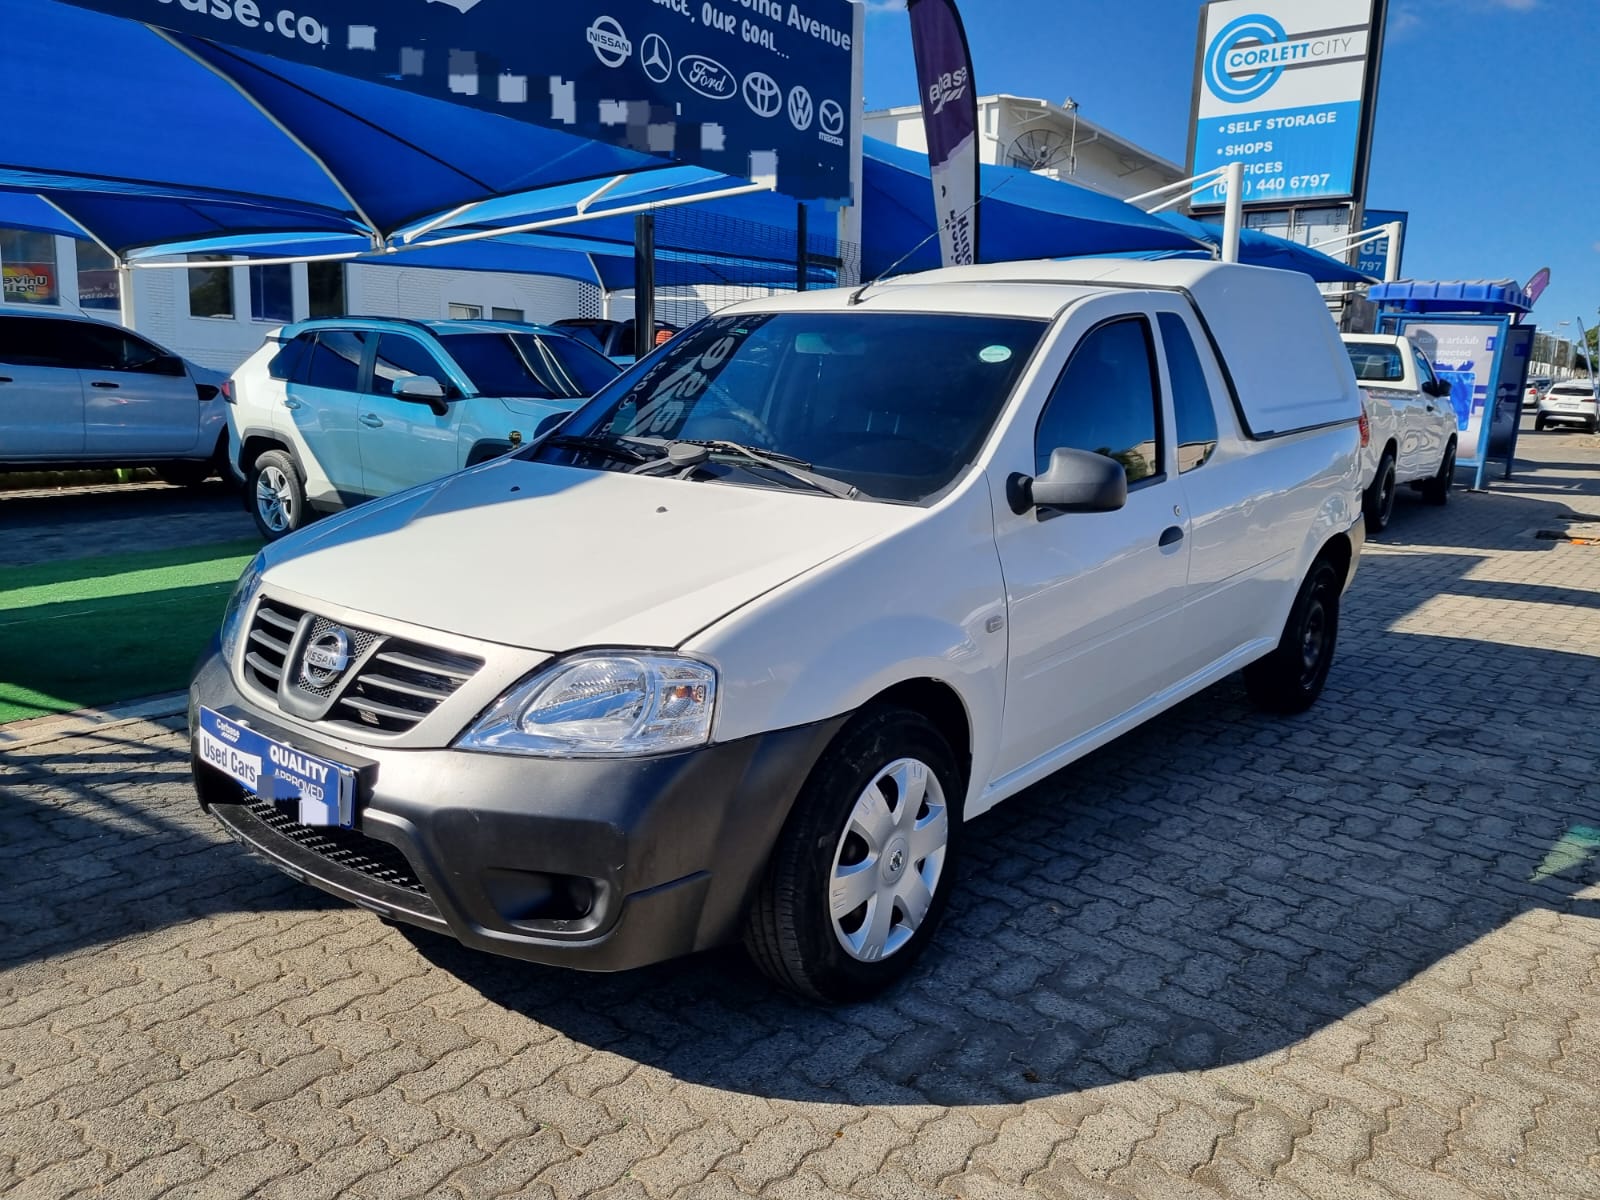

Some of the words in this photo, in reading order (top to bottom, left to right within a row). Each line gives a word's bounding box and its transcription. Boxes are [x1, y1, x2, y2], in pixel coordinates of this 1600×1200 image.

[589, 31, 630, 52] NISSAN
[701, 2, 737, 35] OUR
[741, 19, 791, 60] GOAL...
[786, 4, 852, 52] Avenue
[689, 61, 727, 93] Ford
[1227, 119, 1262, 135] SELF
[1266, 112, 1337, 131] STORAGE
[1225, 141, 1273, 156] SHOPS
[1244, 161, 1283, 175] FICES
[1256, 177, 1286, 191] 440
[1290, 173, 1330, 189] 6797
[203, 735, 228, 767] Used
[230, 751, 256, 783] Cars
[269, 744, 329, 784] QUALITY
[274, 768, 324, 801] APPROVED
